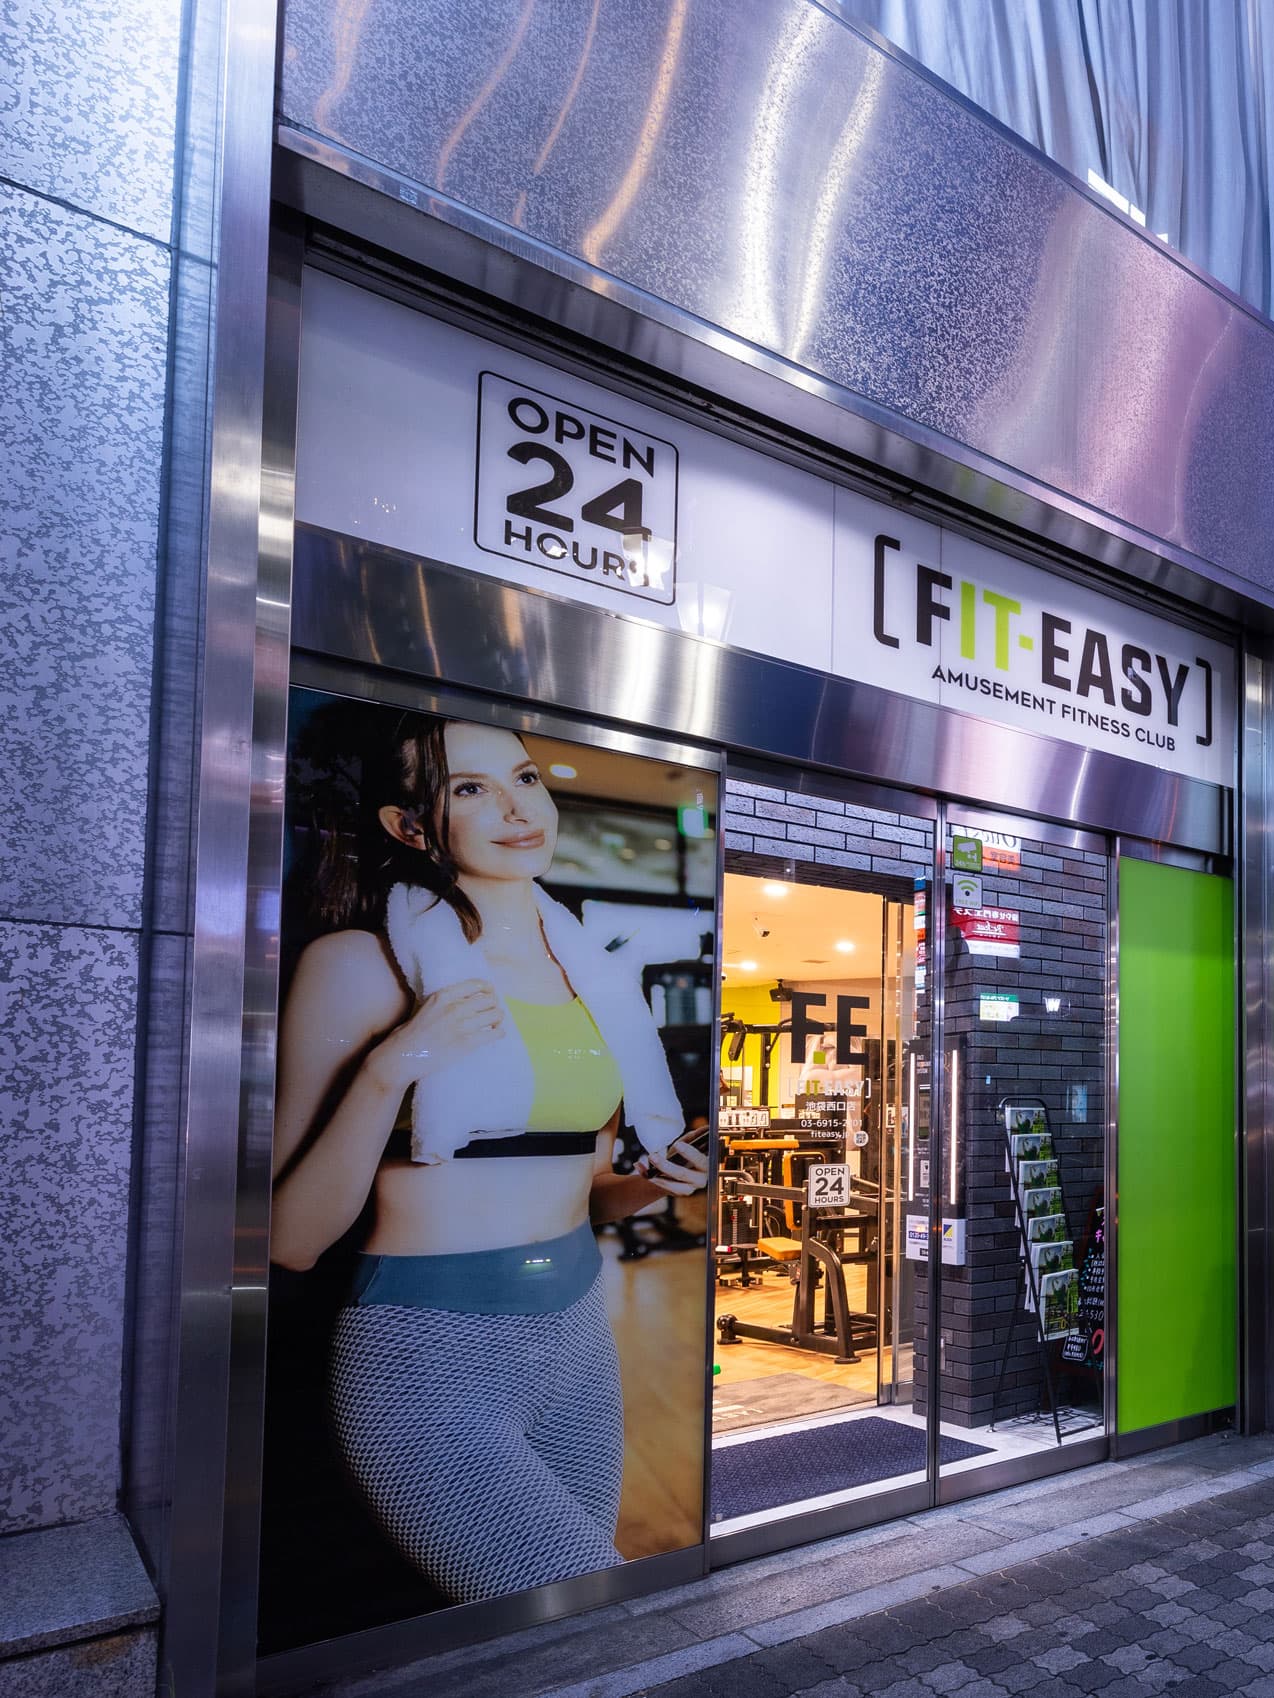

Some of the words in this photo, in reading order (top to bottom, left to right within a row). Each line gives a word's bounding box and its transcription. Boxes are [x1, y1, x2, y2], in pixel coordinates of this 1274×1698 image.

[507, 397, 655, 478] OPEN
[507, 441, 653, 541] 24
[931, 664, 1056, 715] AMUSEMENT
[1061, 704, 1131, 738] FITNESS
[1134, 727, 1176, 751] CLUB
[814, 1177, 845, 1196] 24
[815, 1167, 845, 1177] OPEN
[814, 1195, 845, 1204] HOURS
